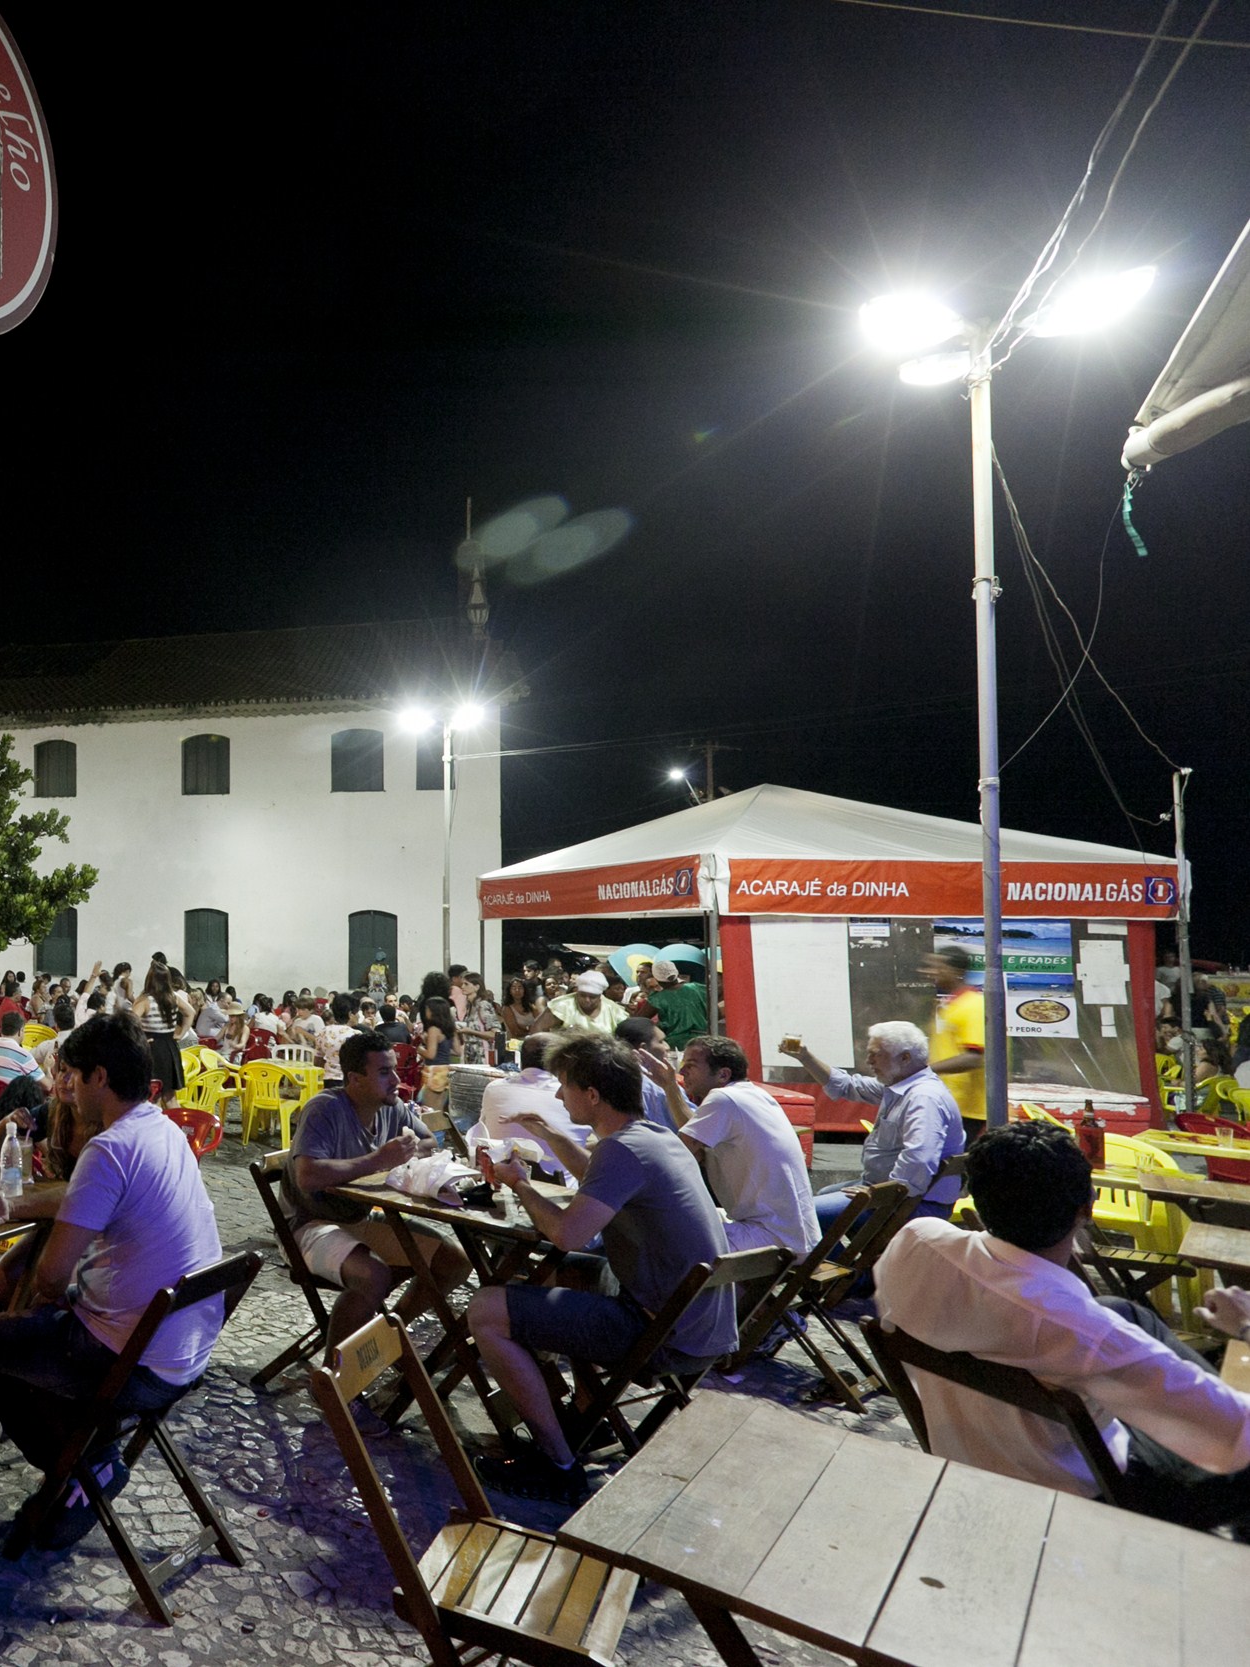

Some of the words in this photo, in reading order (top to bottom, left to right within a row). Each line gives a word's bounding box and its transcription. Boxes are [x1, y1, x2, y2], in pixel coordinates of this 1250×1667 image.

[736, 877, 822, 896] ACARAJÉ
[826, 881, 847, 896] da
[852, 881, 909, 897] DINHA
[525, 890, 551, 904] DINHA
[1019, 956, 1067, 965] FRADES
